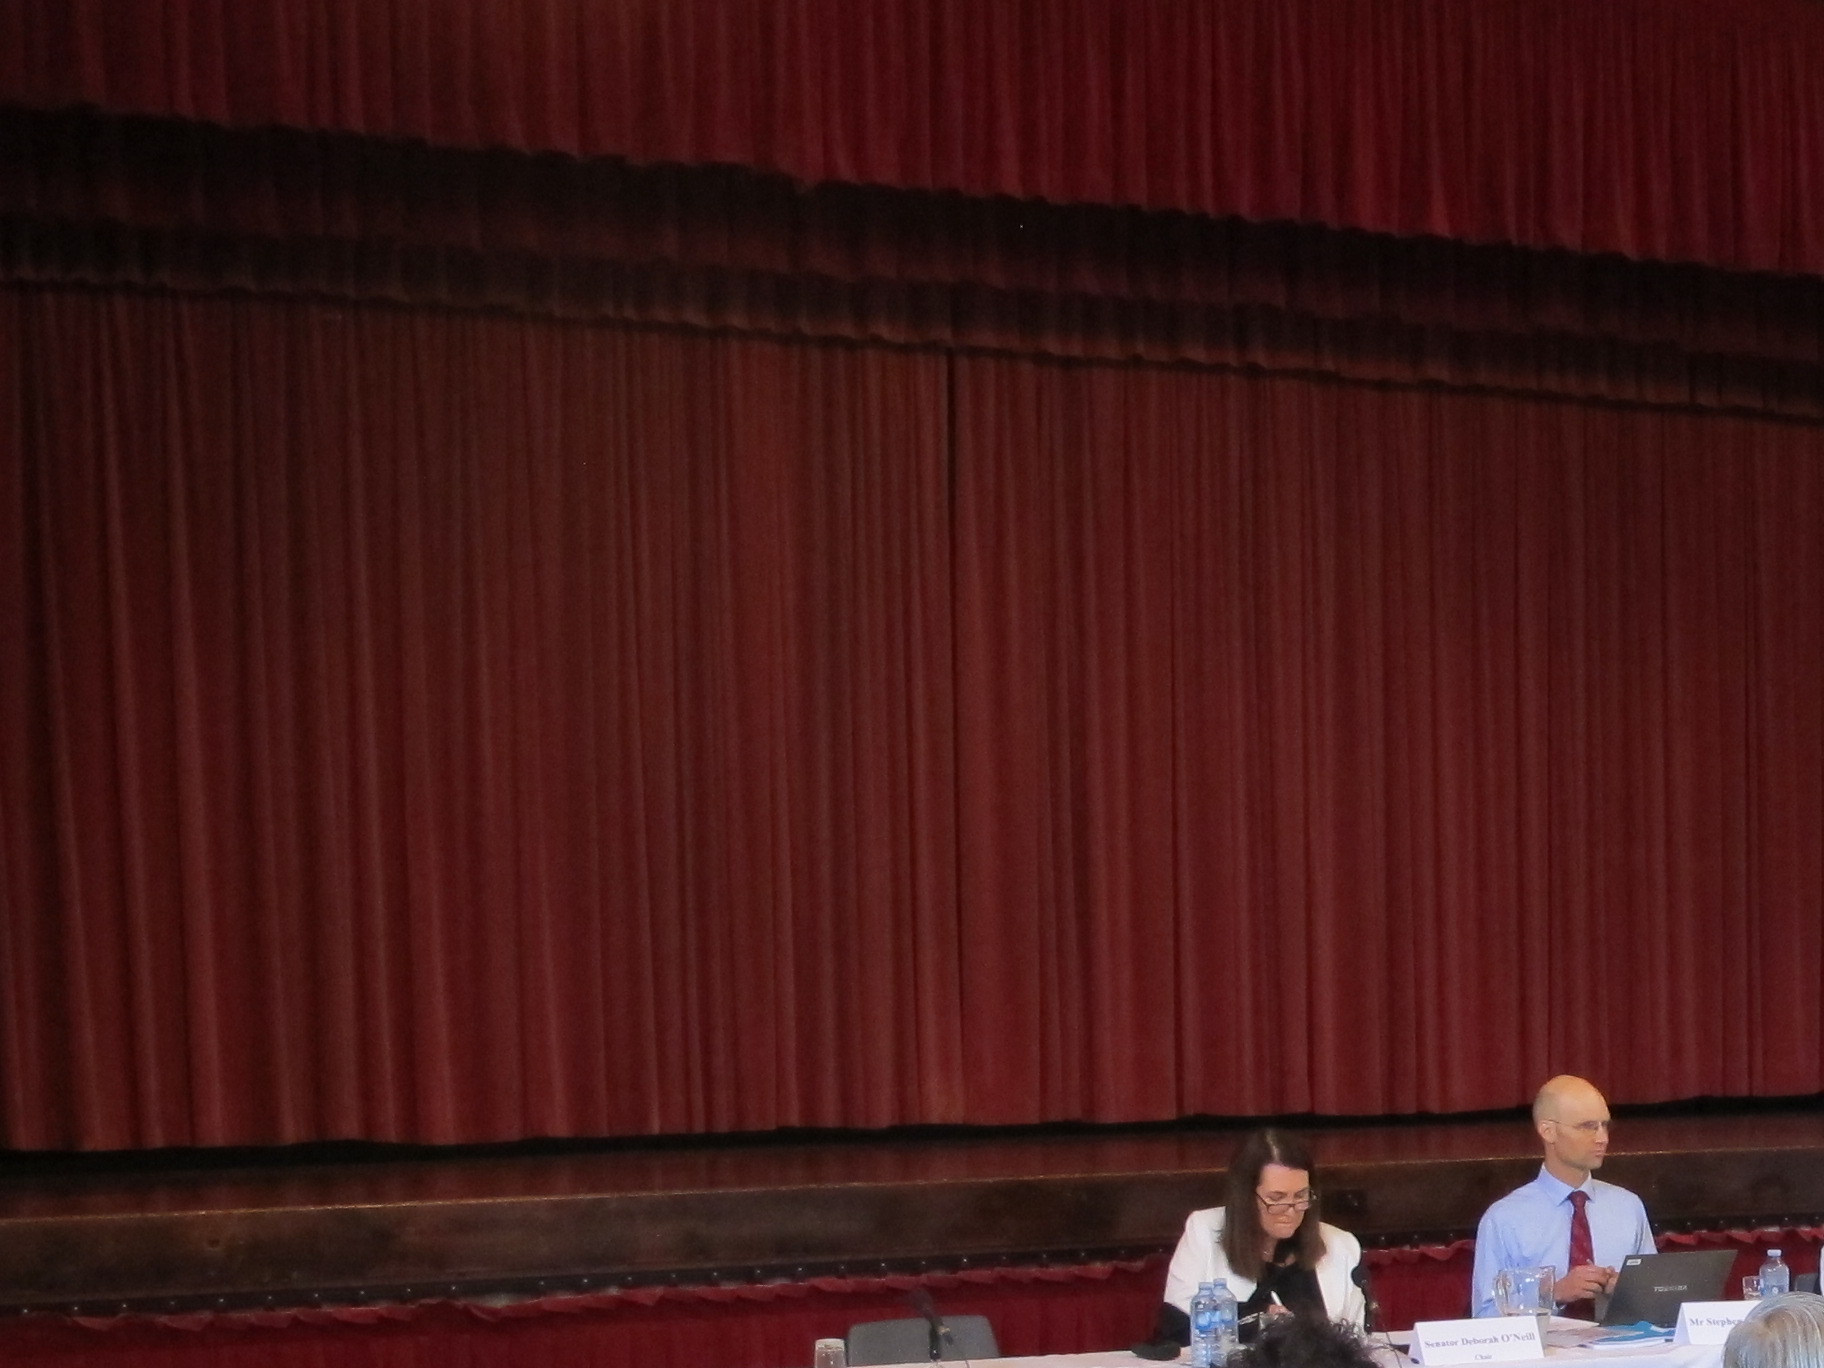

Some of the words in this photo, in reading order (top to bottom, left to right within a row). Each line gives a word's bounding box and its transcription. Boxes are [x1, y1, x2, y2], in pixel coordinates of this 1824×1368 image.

[1689, 1318, 1704, 1326] Mr
[1424, 1340, 1459, 1349] Senator
[1461, 1335, 1499, 1346] Deborah
[1501, 1332, 1536, 1343] O'Neill
